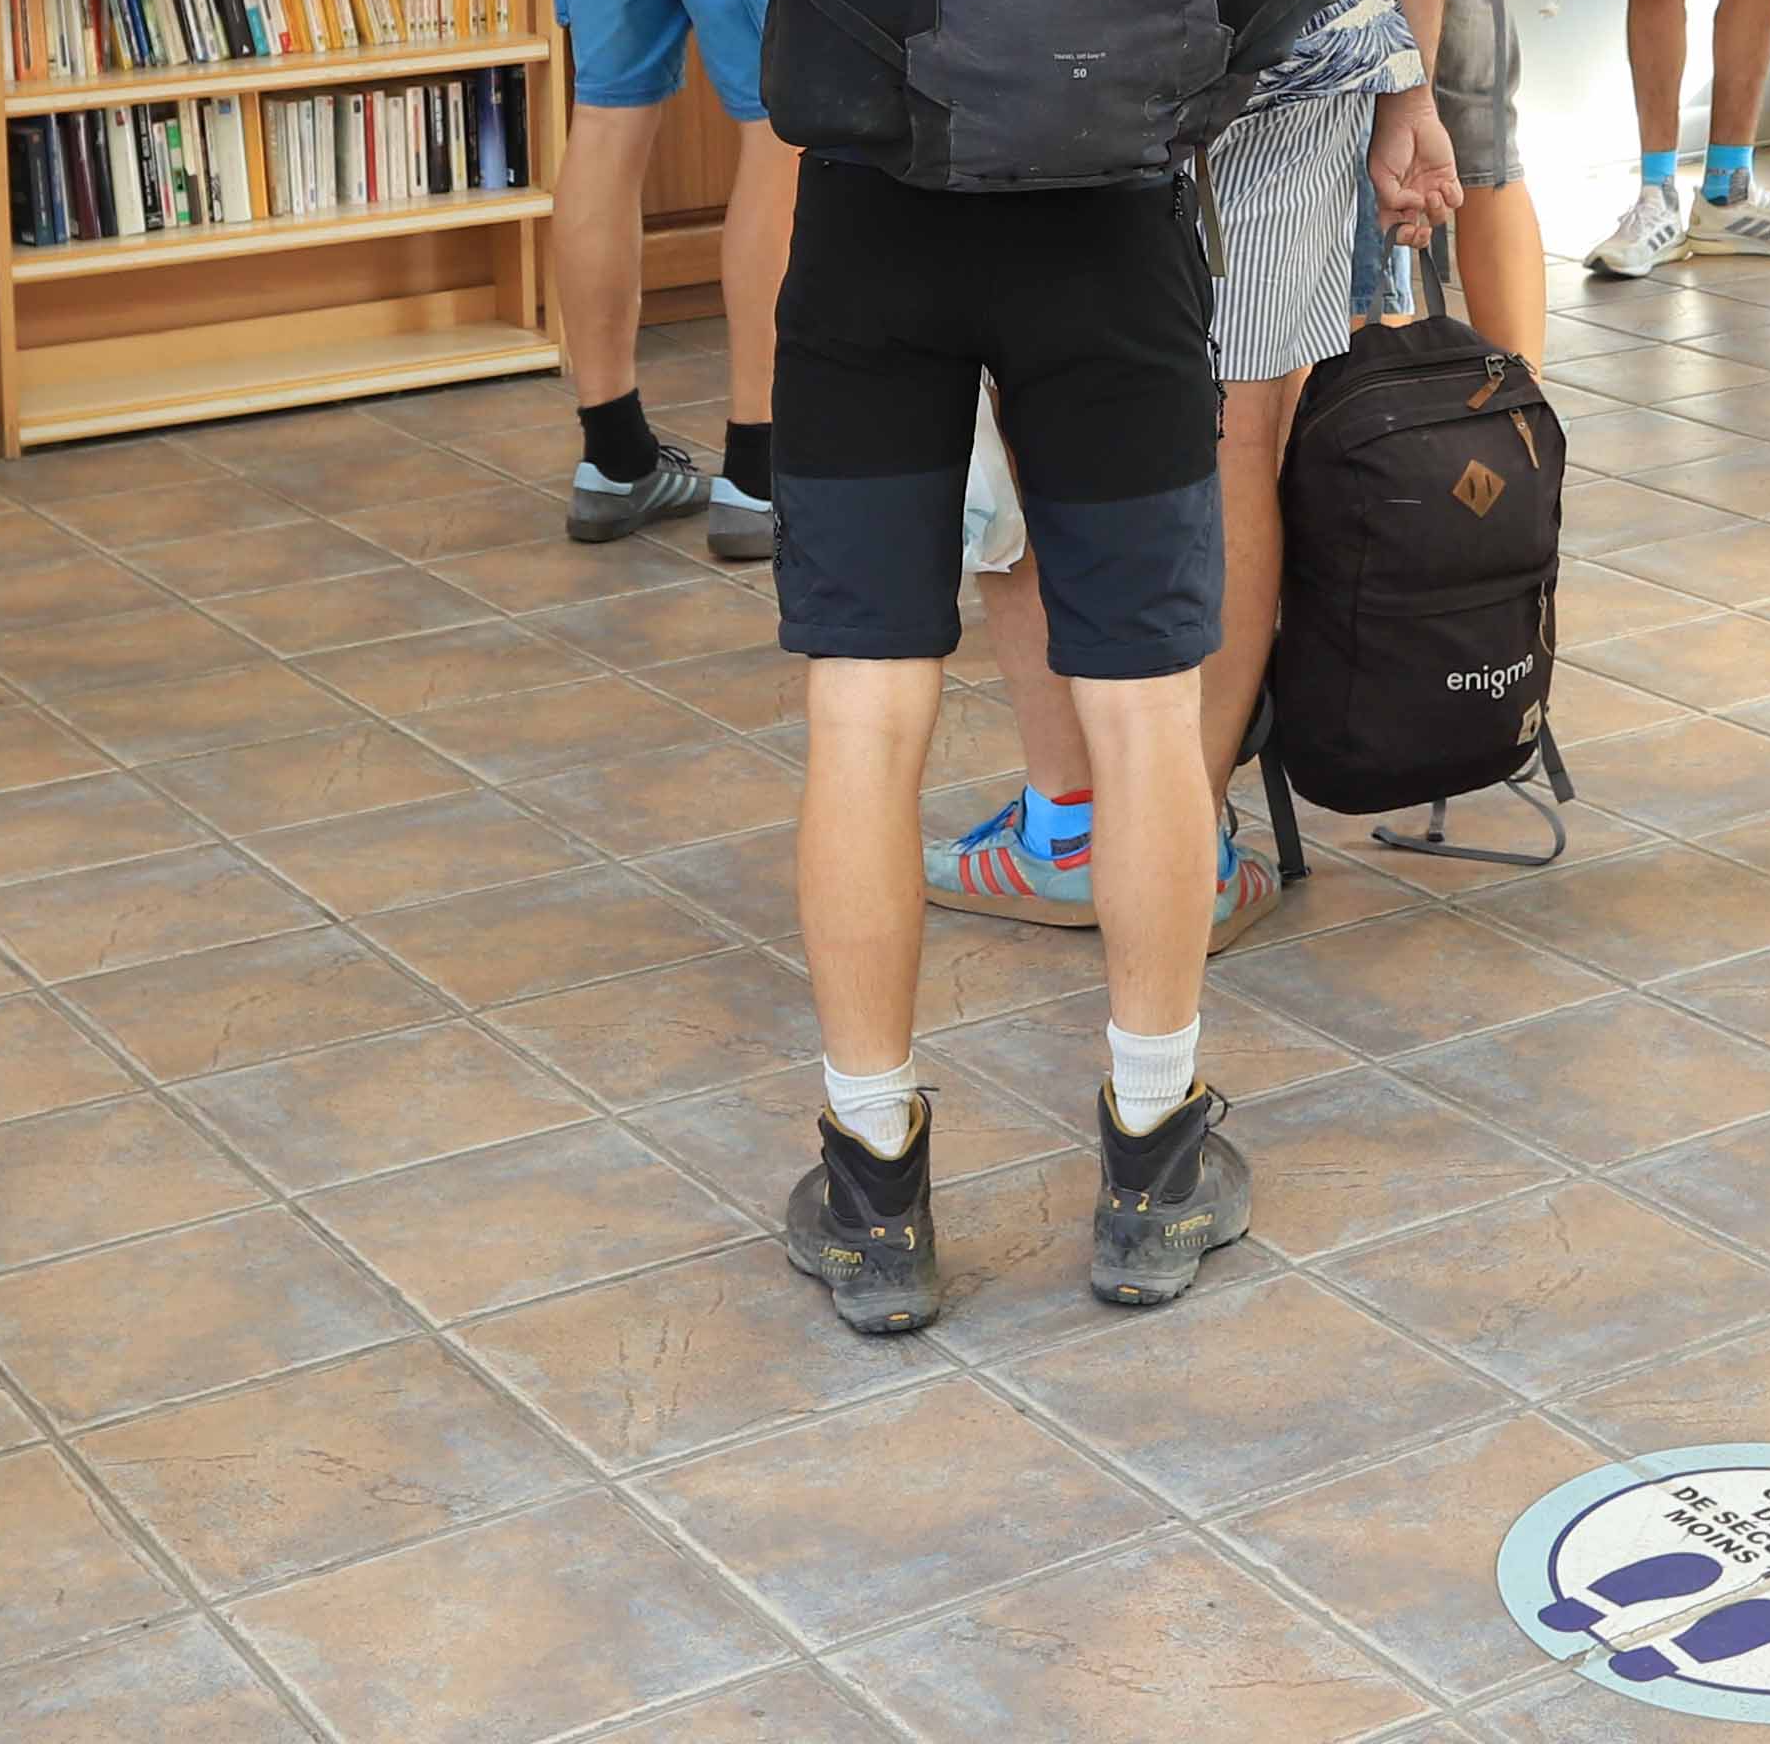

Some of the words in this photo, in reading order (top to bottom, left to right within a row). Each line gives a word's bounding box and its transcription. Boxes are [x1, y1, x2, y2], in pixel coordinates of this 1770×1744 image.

[1072, 67, 1088, 79] 50
[1446, 653, 1534, 699] enigma
[1671, 1486, 1718, 1513] DE
[1664, 1508, 1761, 1565] MOINS
